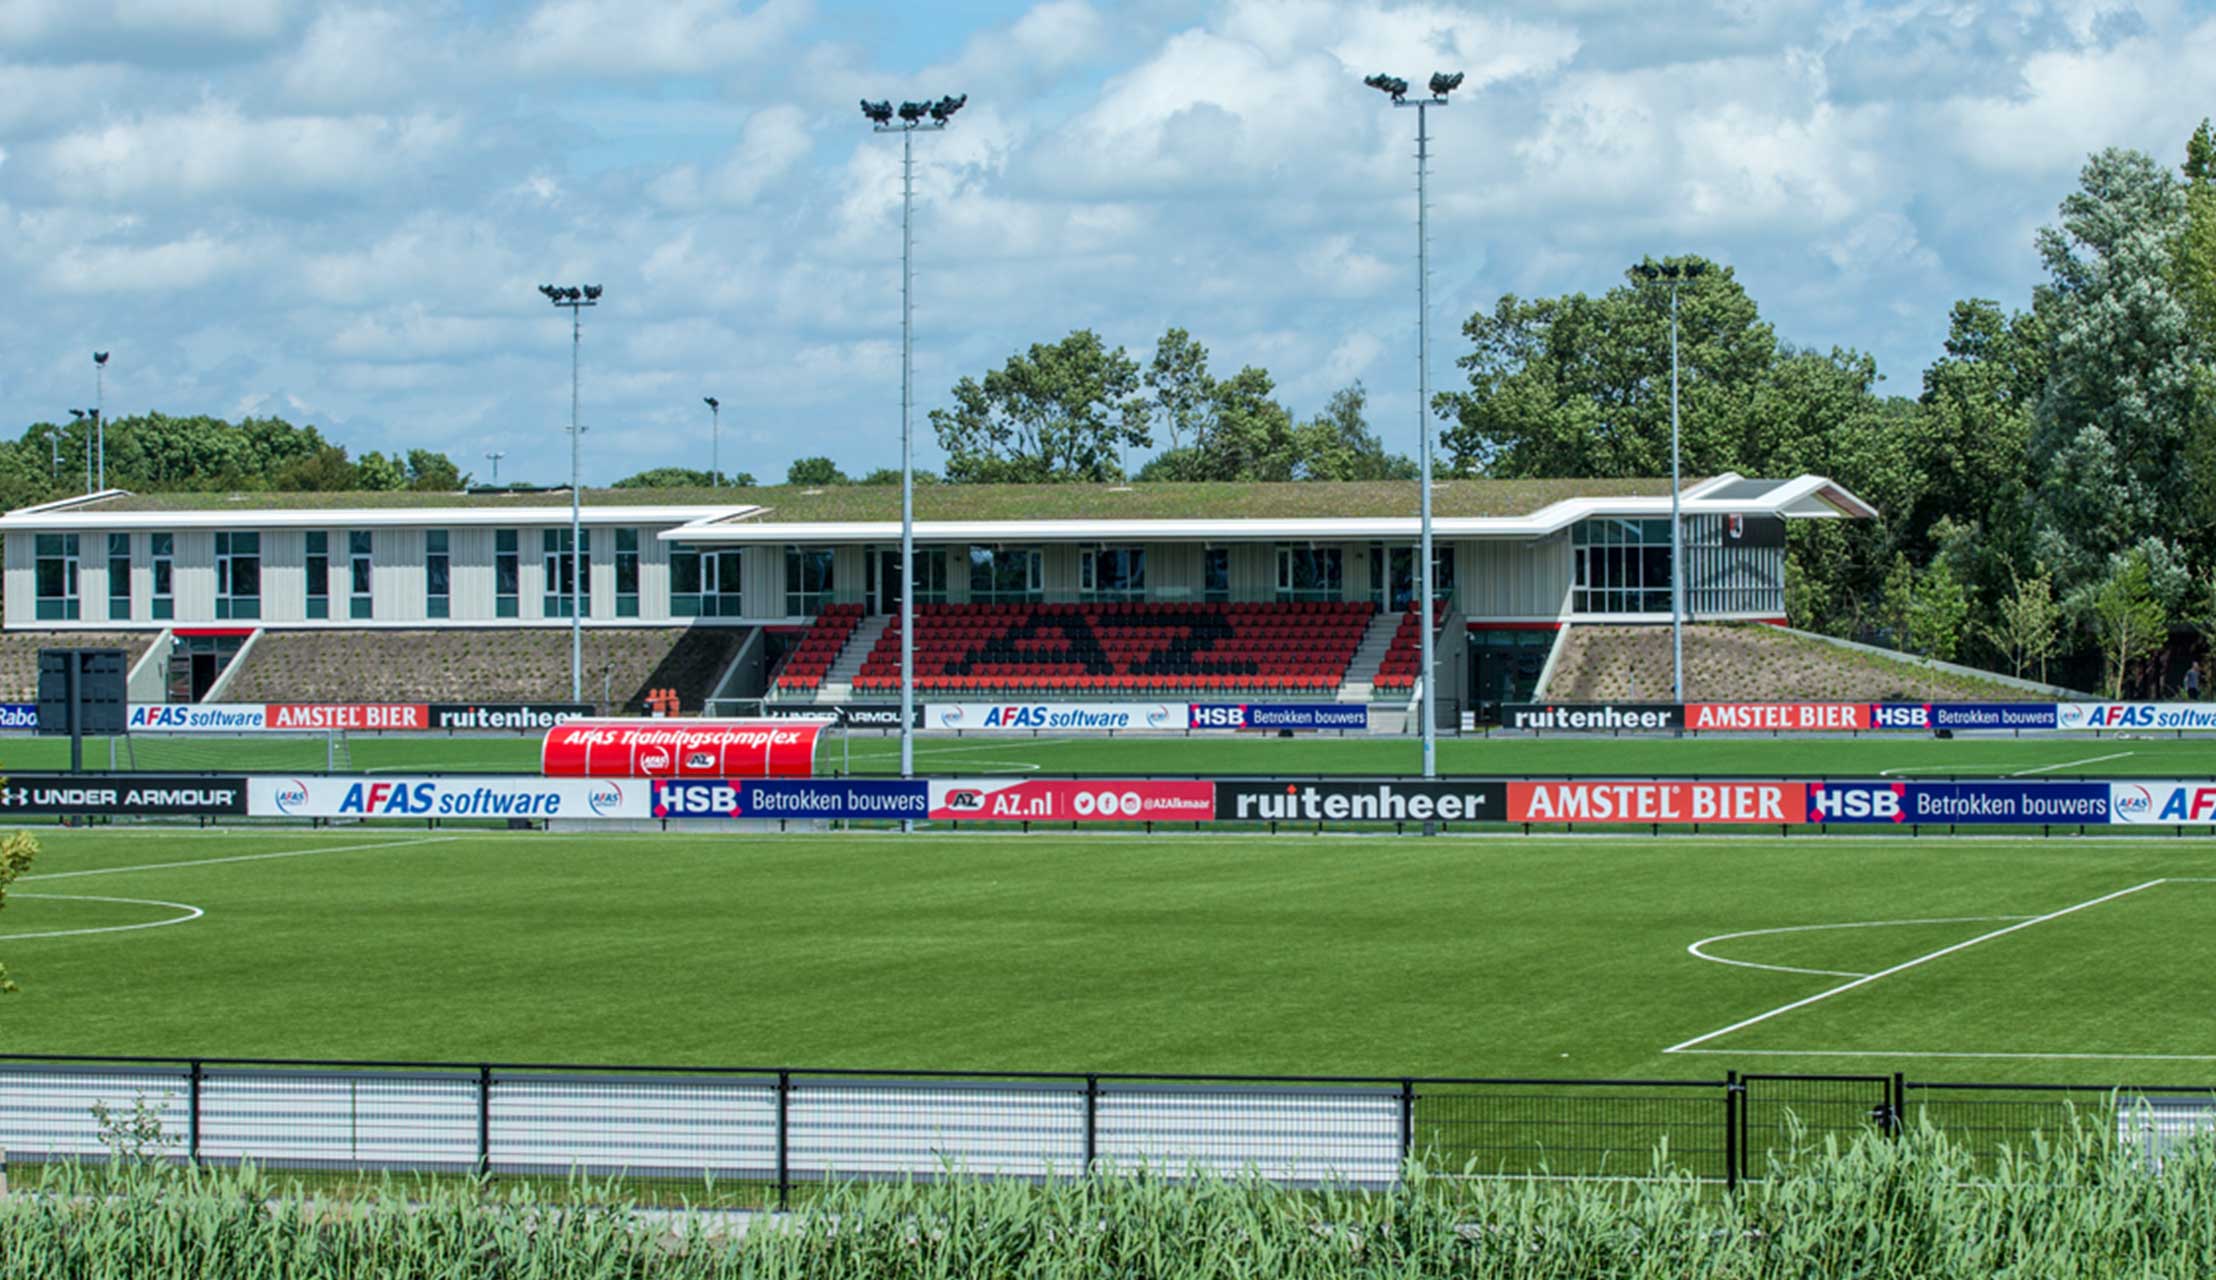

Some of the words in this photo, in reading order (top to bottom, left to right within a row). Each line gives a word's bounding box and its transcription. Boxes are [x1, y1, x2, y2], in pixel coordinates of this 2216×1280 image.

[130, 707, 188, 726] AFAS
[190, 709, 263, 726] software
[276, 707, 359, 726] AMSTEL
[366, 707, 417, 726] BIER
[984, 707, 1047, 727] AFAS
[1050, 709, 1129, 727] software
[1194, 708, 1244, 726] HSB
[1253, 711, 1312, 724] Betrokken
[1315, 711, 1365, 724] bouwers
[1515, 706, 1671, 727] ruitenheer
[1697, 706, 1793, 727] AMSTEL
[1800, 707, 1857, 727] BIER
[1876, 708, 1930, 726] HSB
[1938, 709, 1999, 724] Betrokken
[2003, 709, 2054, 724] bouwers
[2087, 706, 2155, 727] AFAS
[564, 731, 618, 745] AFAS
[34, 790, 117, 805] UNDER
[123, 790, 232, 805] ARMOUR
[339, 783, 435, 813] AFAS
[438, 788, 561, 814] software
[660, 787, 736, 812] HSB
[752, 789, 842, 810] Betrokken
[848, 789, 925, 811] bouwers
[952, 793, 979, 807] AZ
[992, 792, 1052, 815] AZ.nl
[1143, 799, 1210, 810] @AZAlkmaar
[1236, 784, 1485, 819] ruitenheer
[1691, 786, 1785, 819] BIER
[1816, 790, 1900, 817] HSB
[1917, 793, 2015, 815] Betrokken
[2022, 793, 2107, 815] bouwers
[2120, 798, 2148, 809] AFAS
